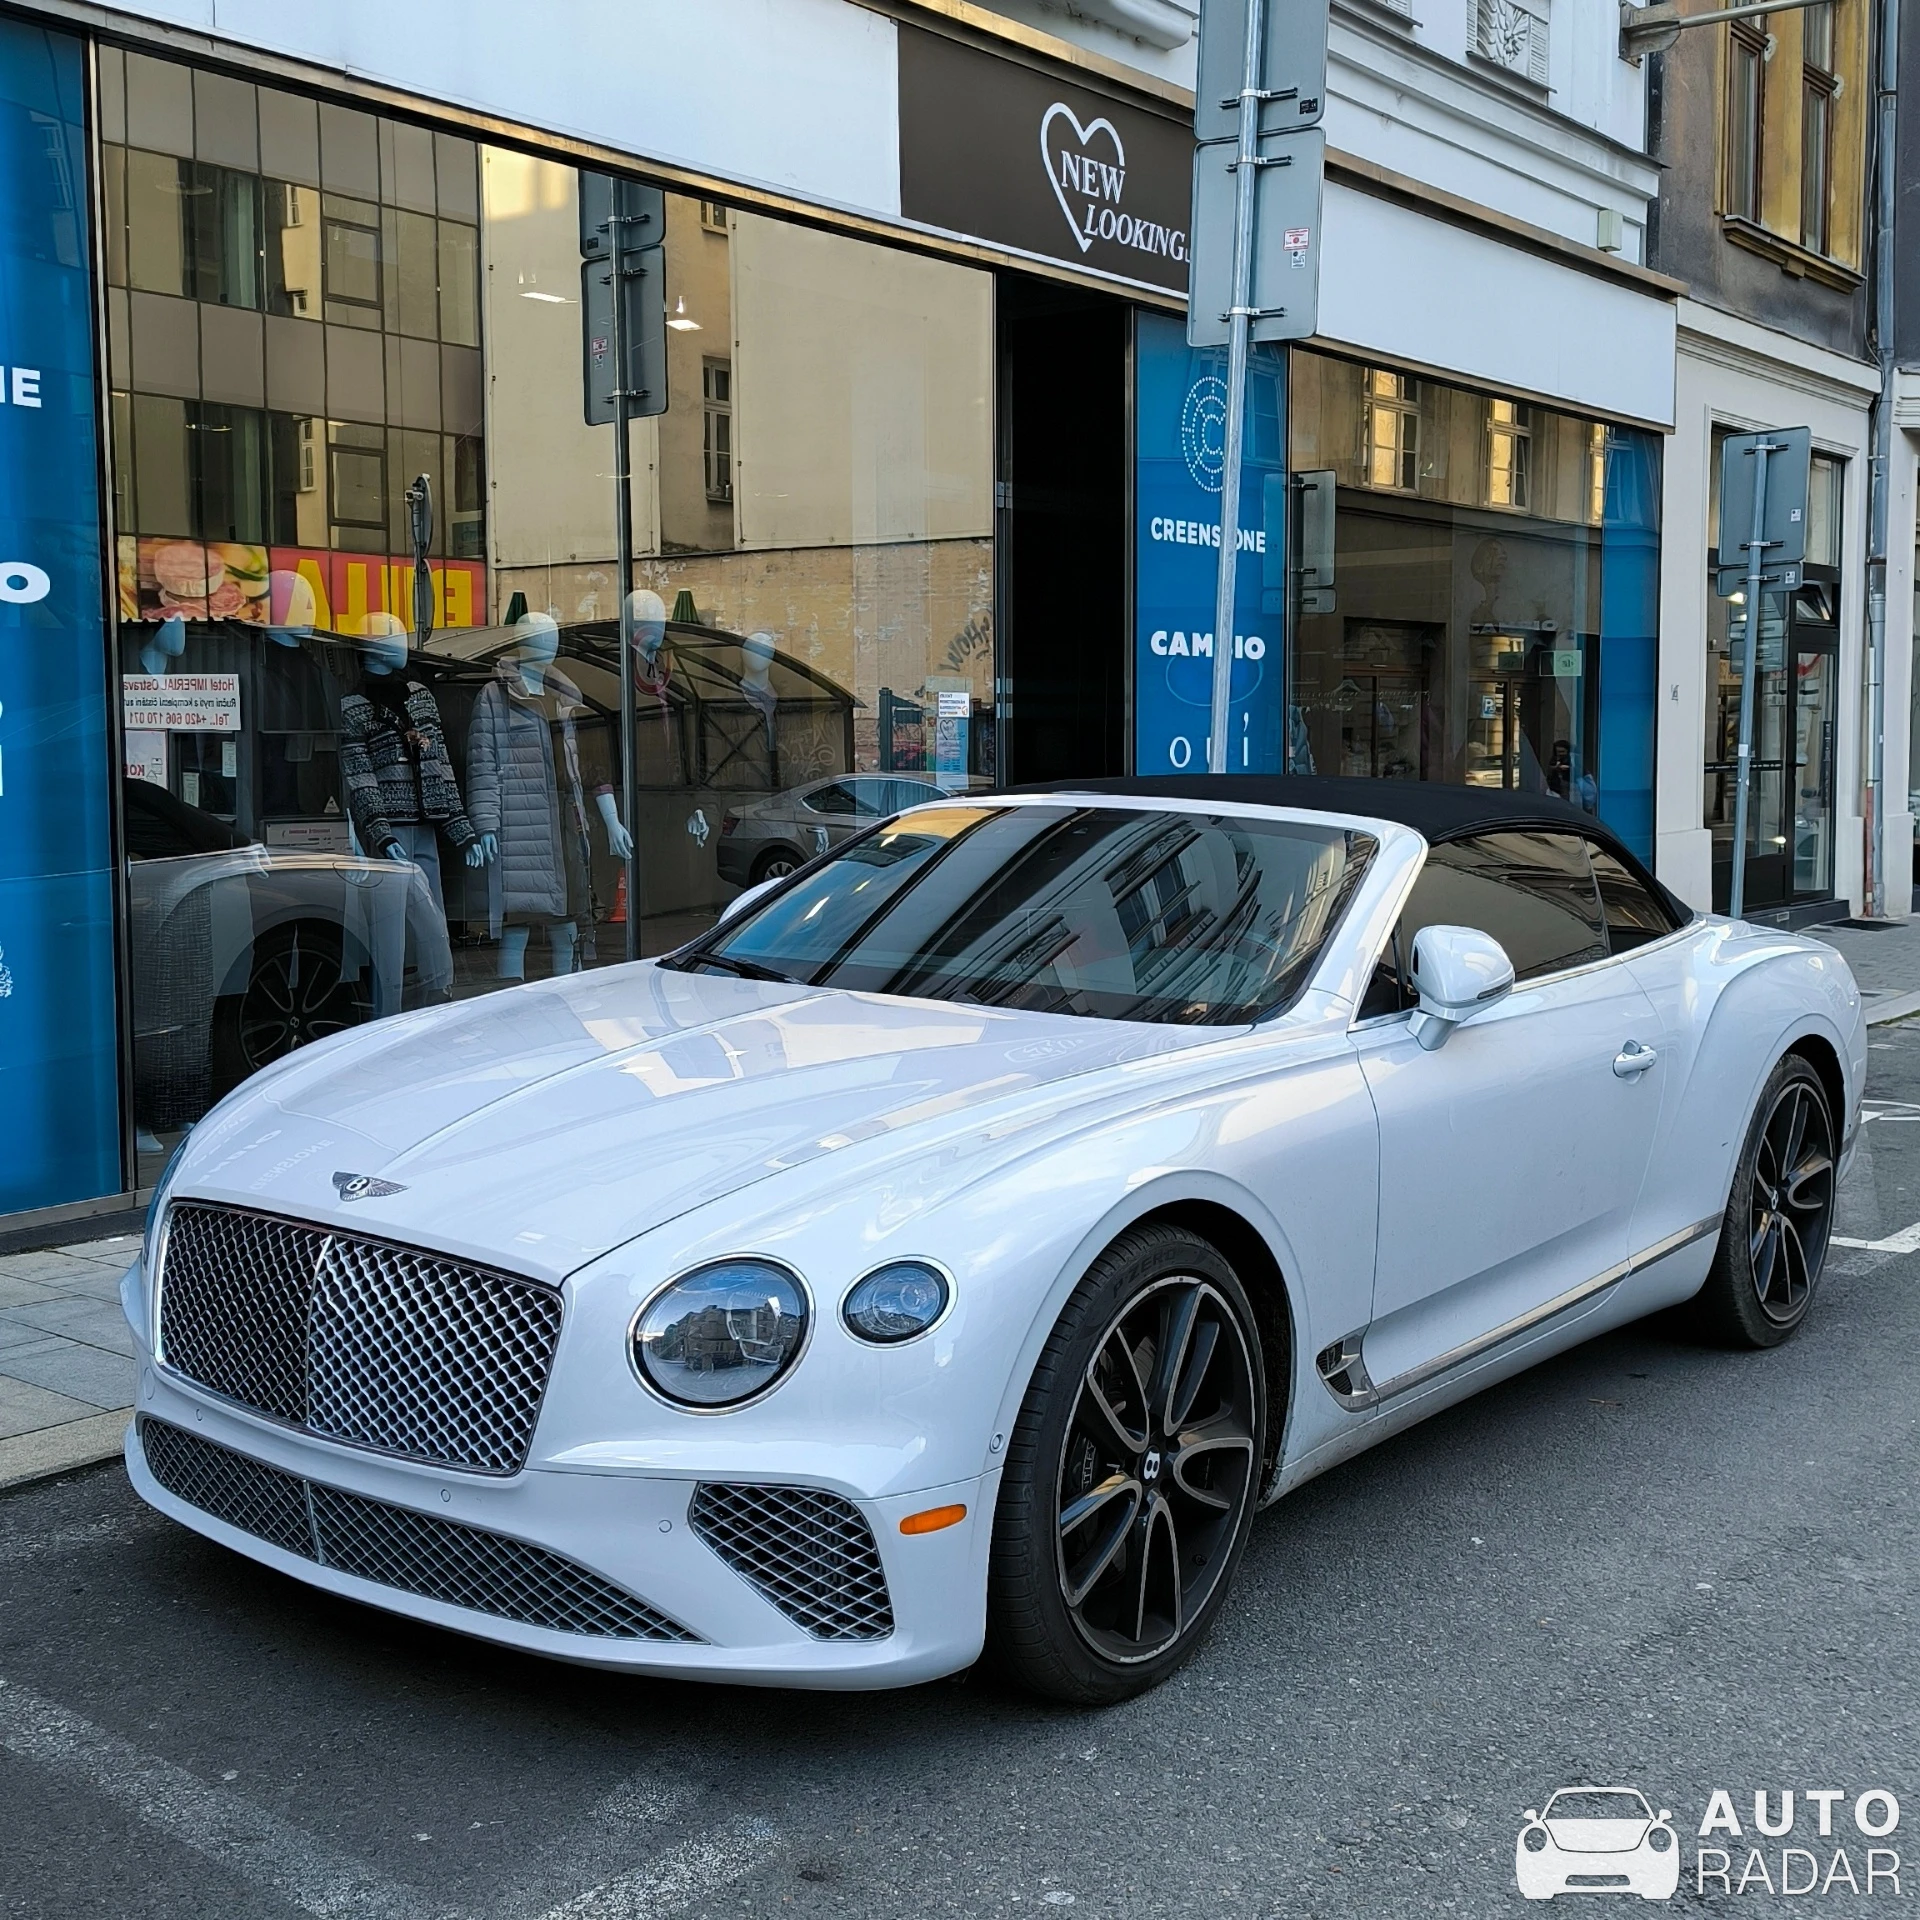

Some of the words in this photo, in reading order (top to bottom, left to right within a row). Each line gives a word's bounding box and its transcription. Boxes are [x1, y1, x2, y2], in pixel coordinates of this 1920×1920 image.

[1061, 150, 1125, 204] NEW
[1084, 204, 1186, 261] LOOKING
[1151, 517, 1266, 553] CREENSONE
[1151, 630, 1266, 660] CAMIO
